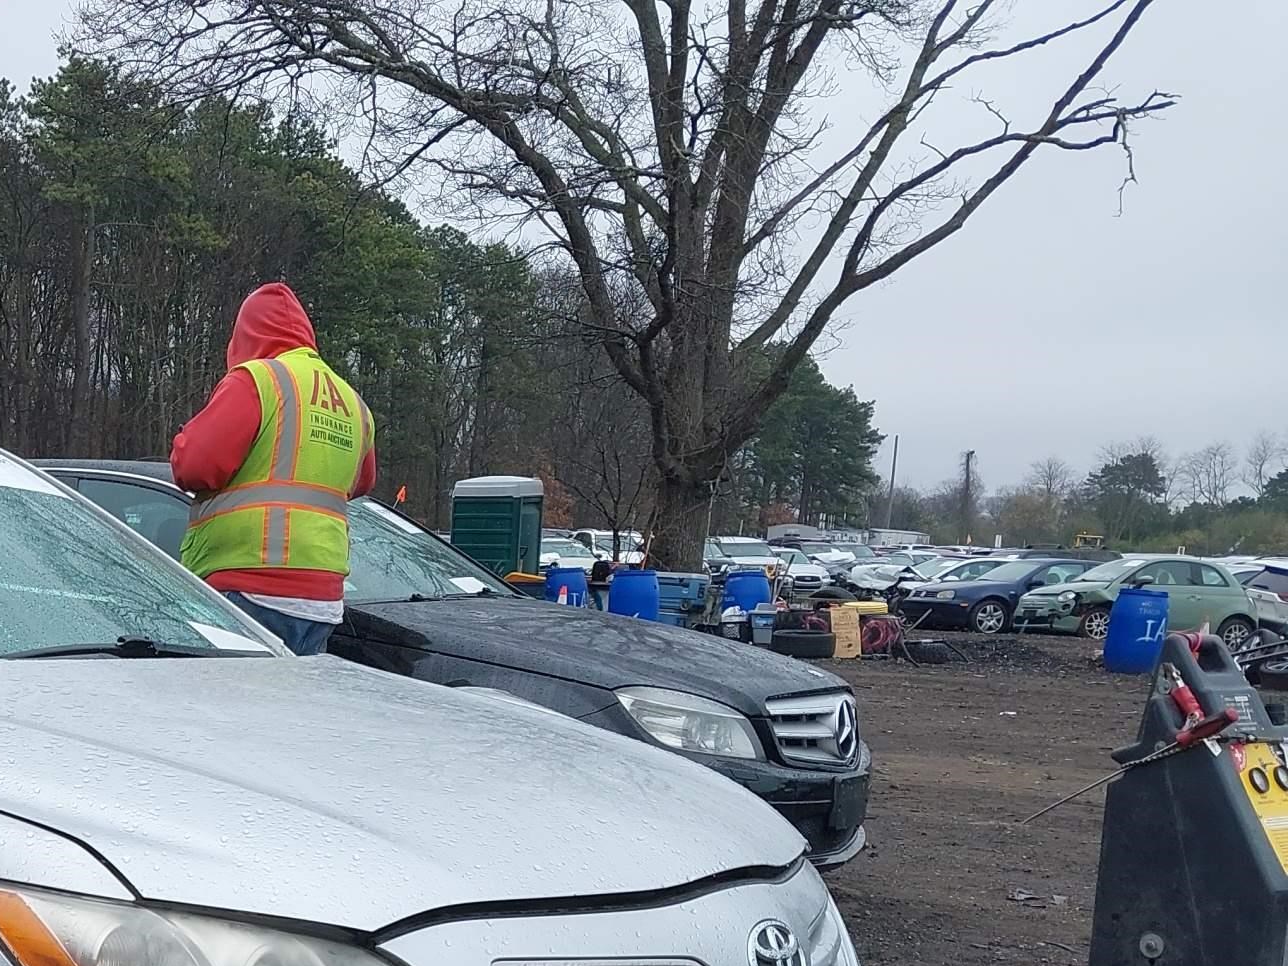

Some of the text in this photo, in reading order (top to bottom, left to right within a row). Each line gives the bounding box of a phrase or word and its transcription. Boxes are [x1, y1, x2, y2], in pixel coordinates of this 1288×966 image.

[310, 413, 352, 435] INSURANCE
[310, 428, 353, 449] AUTO AUCTIONS
